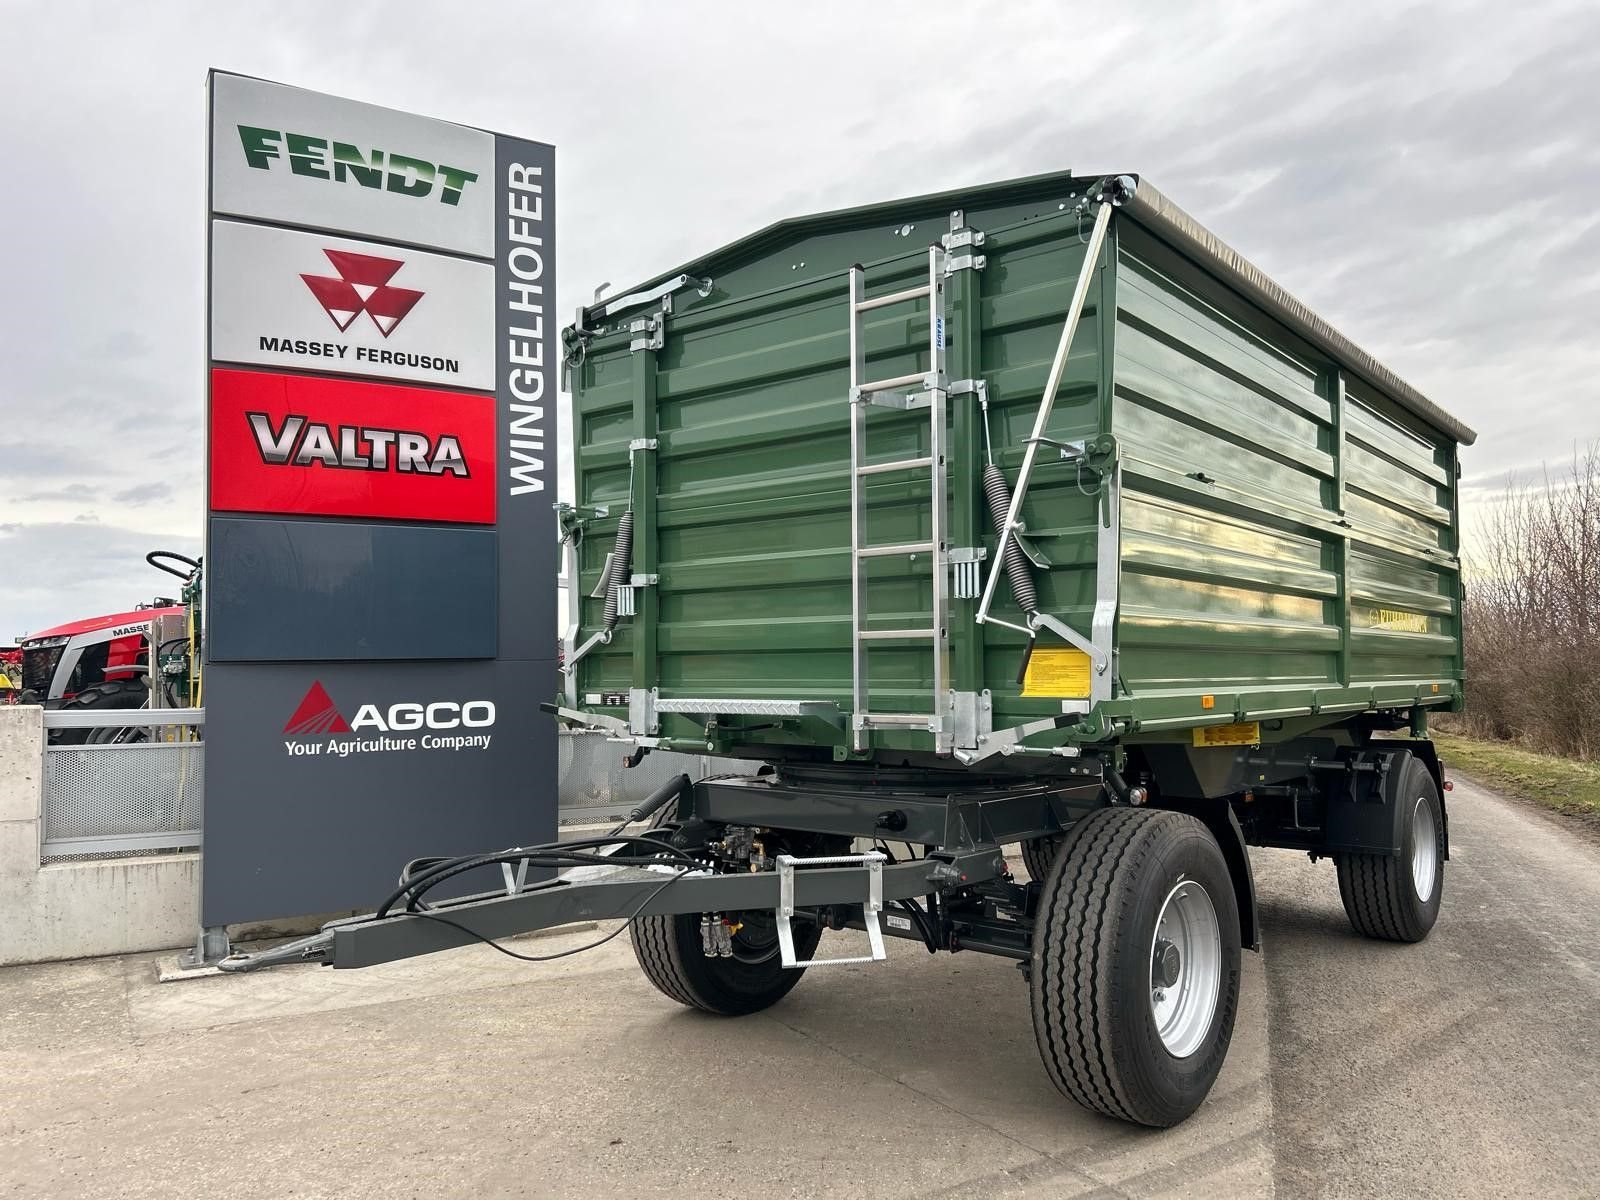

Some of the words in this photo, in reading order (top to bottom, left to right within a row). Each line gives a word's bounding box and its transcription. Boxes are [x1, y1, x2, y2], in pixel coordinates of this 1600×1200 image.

[237, 124, 479, 206] FENDT
[259, 336, 348, 359] MASSEY
[356, 347, 459, 373] FERGUSON
[508, 162, 544, 495] WINGELHOFER
[245, 411, 472, 479] VALTRA
[350, 700, 496, 732] AGCO
[285, 741, 322, 756] Your
[326, 736, 417, 757] Agriculture
[421, 735, 491, 751] Company
